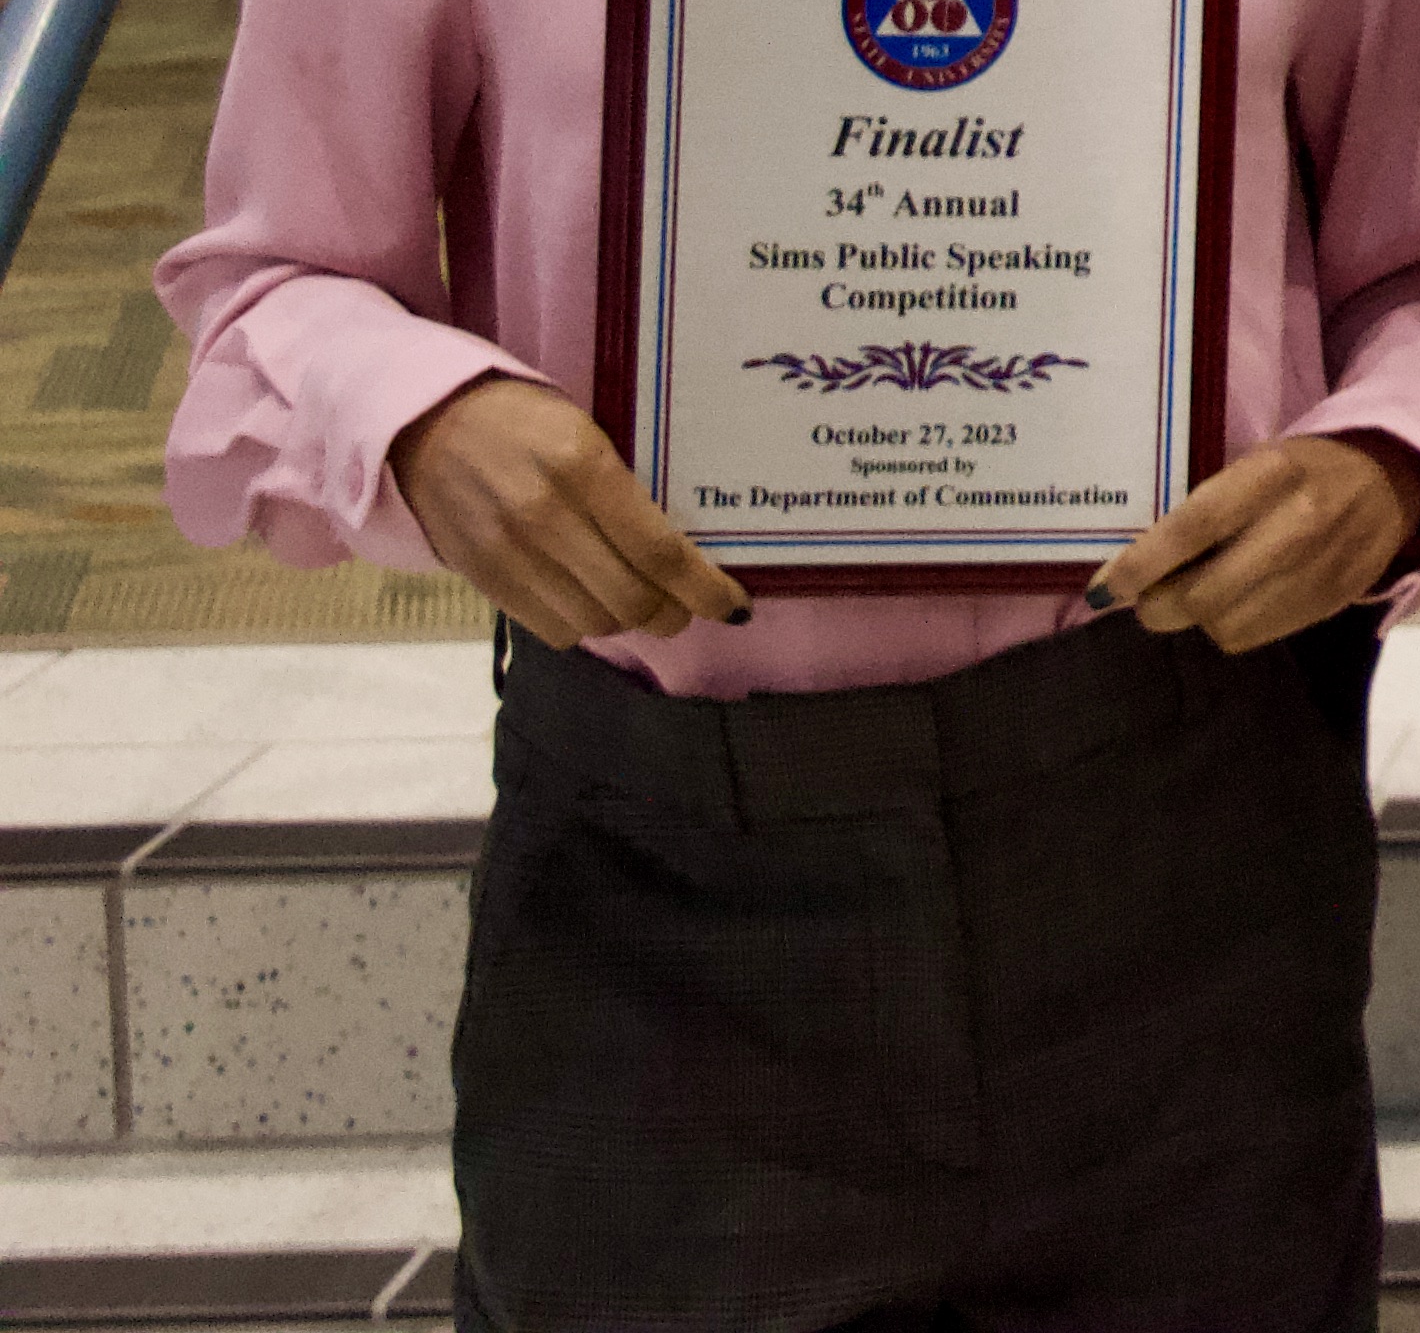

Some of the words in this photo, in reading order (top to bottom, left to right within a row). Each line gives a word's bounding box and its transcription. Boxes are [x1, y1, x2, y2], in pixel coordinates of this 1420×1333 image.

[830, 116, 1024, 159] Finalist
[825, 182, 885, 217] 34th
[893, 189, 1020, 218] Annual
[749, 243, 825, 270] Sims
[837, 242, 936, 270] Public
[946, 243, 1091, 278] Speaking
[820, 283, 1017, 318] Competition
[811, 424, 910, 446] October
[918, 423, 954, 448] 27,
[961, 423, 1017, 446] 2023
[850, 457, 949, 479] Sponsored
[953, 456, 976, 477] by
[694, 486, 742, 508] The
[749, 485, 896, 514] Department
[903, 485, 930, 507] of
[934, 484, 1129, 507] Communication
